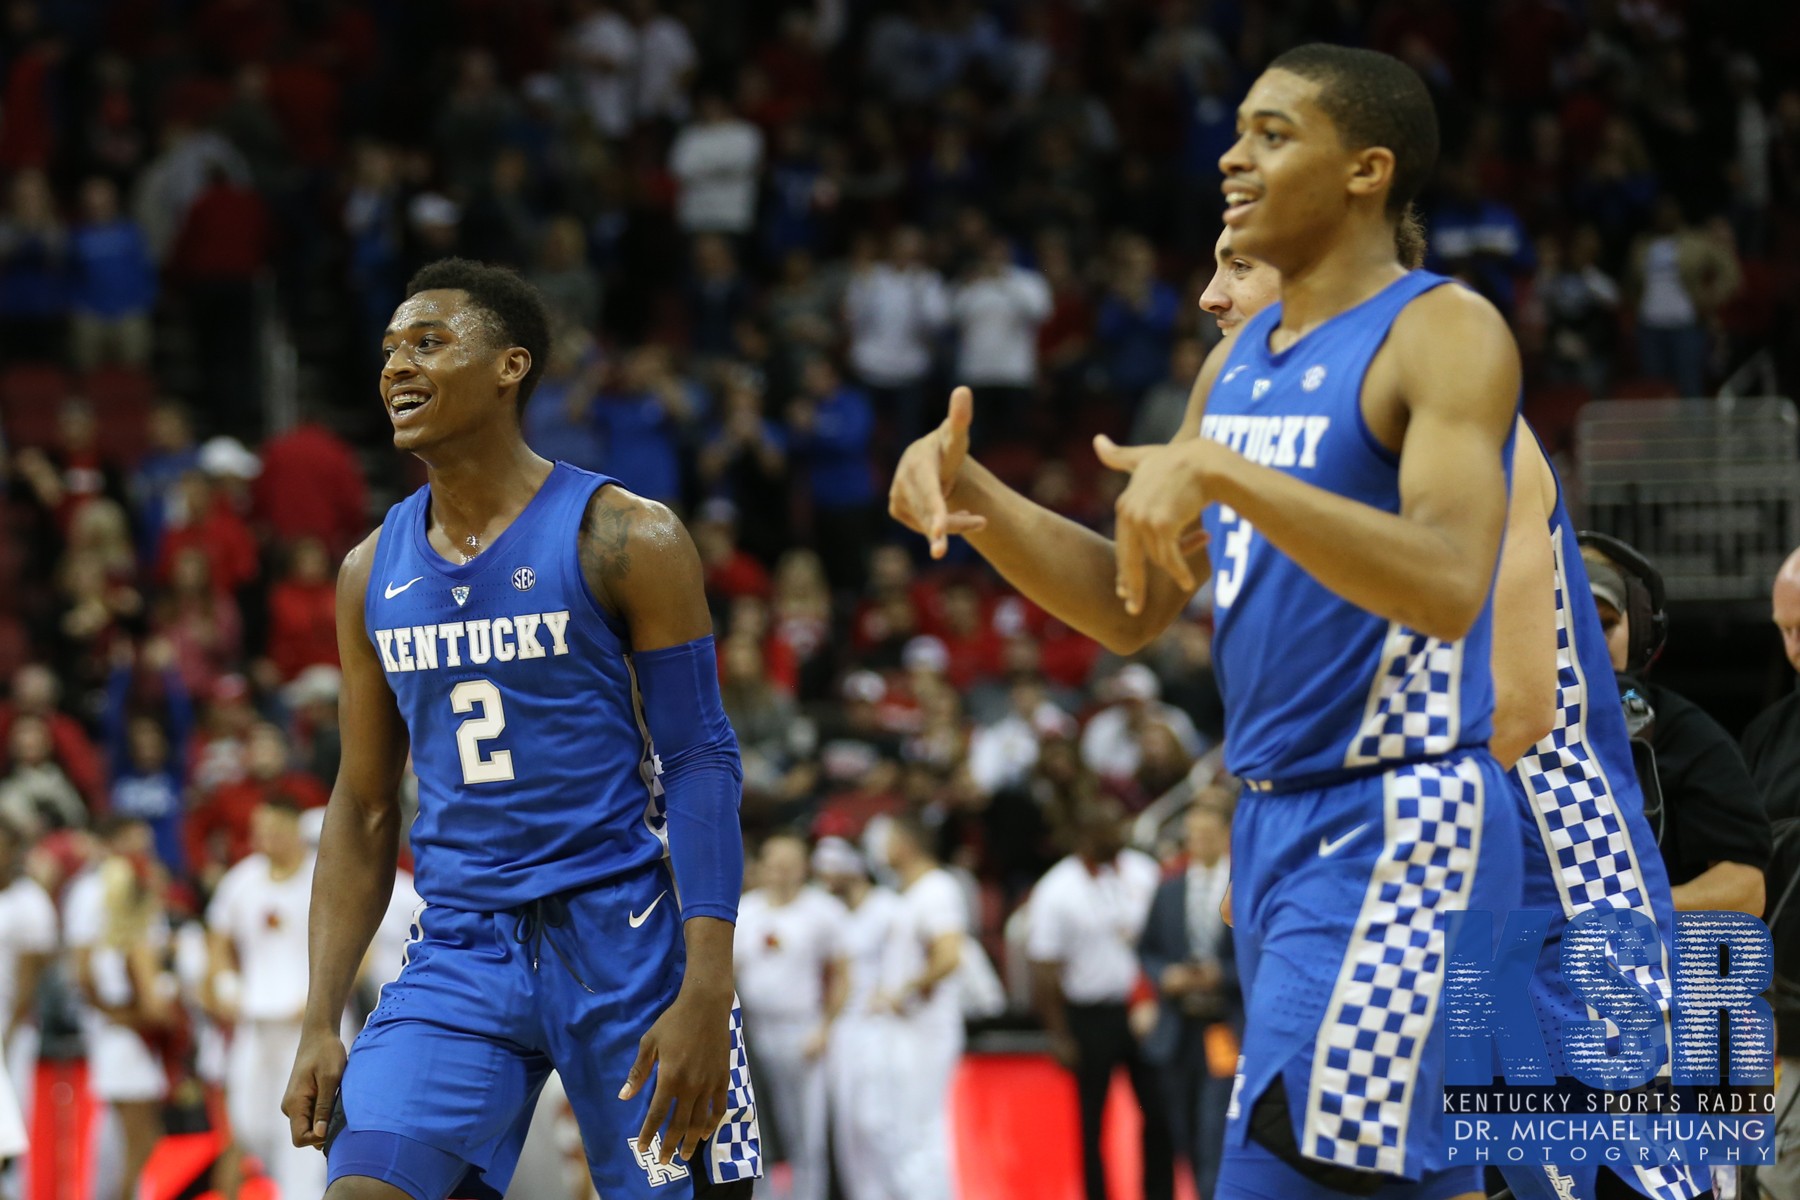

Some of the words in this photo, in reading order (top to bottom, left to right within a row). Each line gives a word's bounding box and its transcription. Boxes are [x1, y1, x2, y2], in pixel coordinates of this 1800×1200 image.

[513, 567, 536, 590] SEC
[1215, 504, 1254, 609] 3
[375, 610, 570, 673] KENTUCKY
[449, 679, 515, 784] 2
